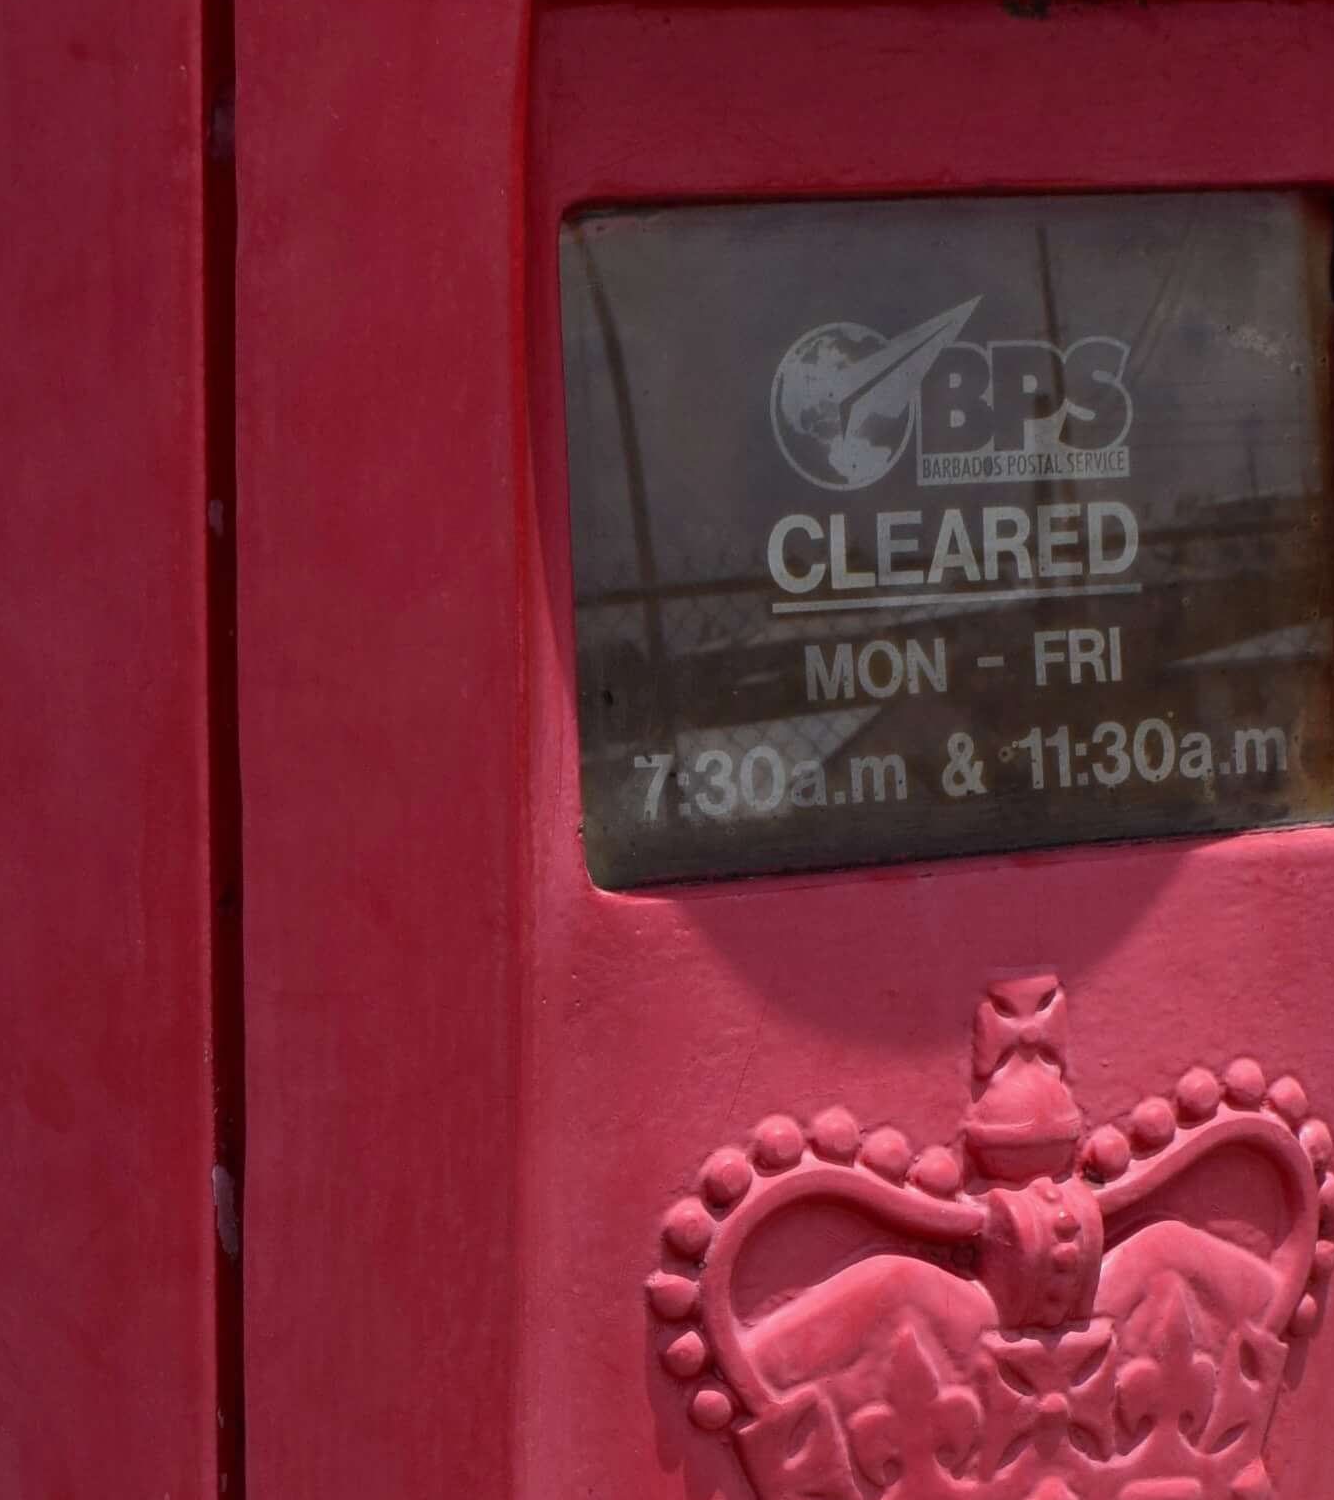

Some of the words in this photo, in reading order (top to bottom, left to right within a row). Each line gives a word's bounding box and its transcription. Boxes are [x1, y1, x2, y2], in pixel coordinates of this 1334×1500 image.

[917, 336, 1133, 454] BPS
[922, 454, 1003, 479] BARBADOS
[1007, 453, 1063, 477] POSTAL
[1066, 451, 1125, 473] SERVICE
[767, 501, 1140, 595] CLEARED
[803, 637, 948, 702] MON
[1033, 626, 1123, 687] FRI
[633, 745, 907, 822] 7:30a.m
[941, 731, 988, 797] &
[1016, 717, 1289, 789] 11:30a.m
